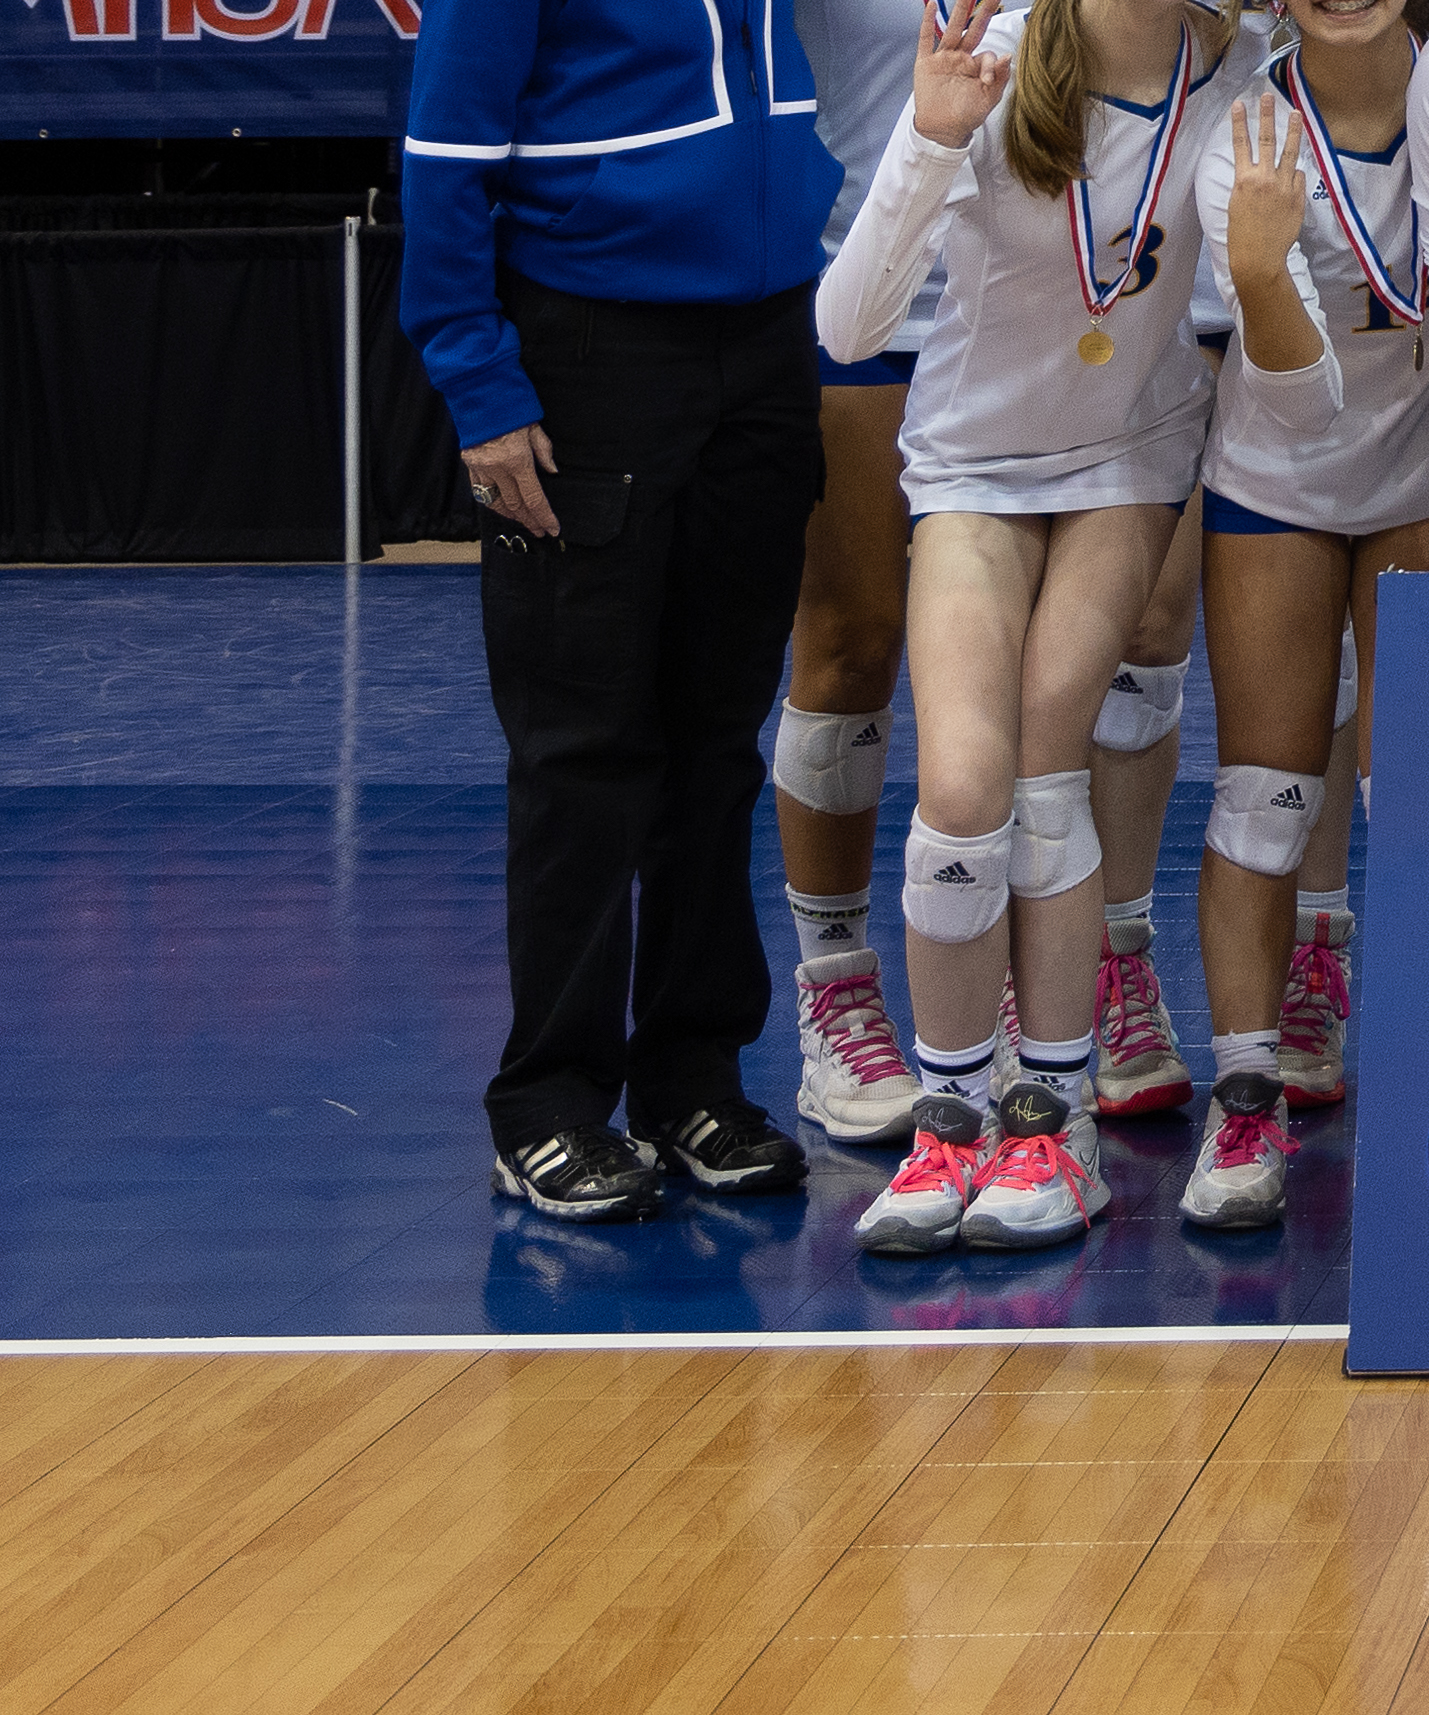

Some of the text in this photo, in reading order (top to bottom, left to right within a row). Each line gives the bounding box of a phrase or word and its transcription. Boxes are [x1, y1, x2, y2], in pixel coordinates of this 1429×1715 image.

[1096, 222, 1167, 299] 3
[1270, 797, 1307, 812] adidas
[933, 873, 977, 885] adidas
